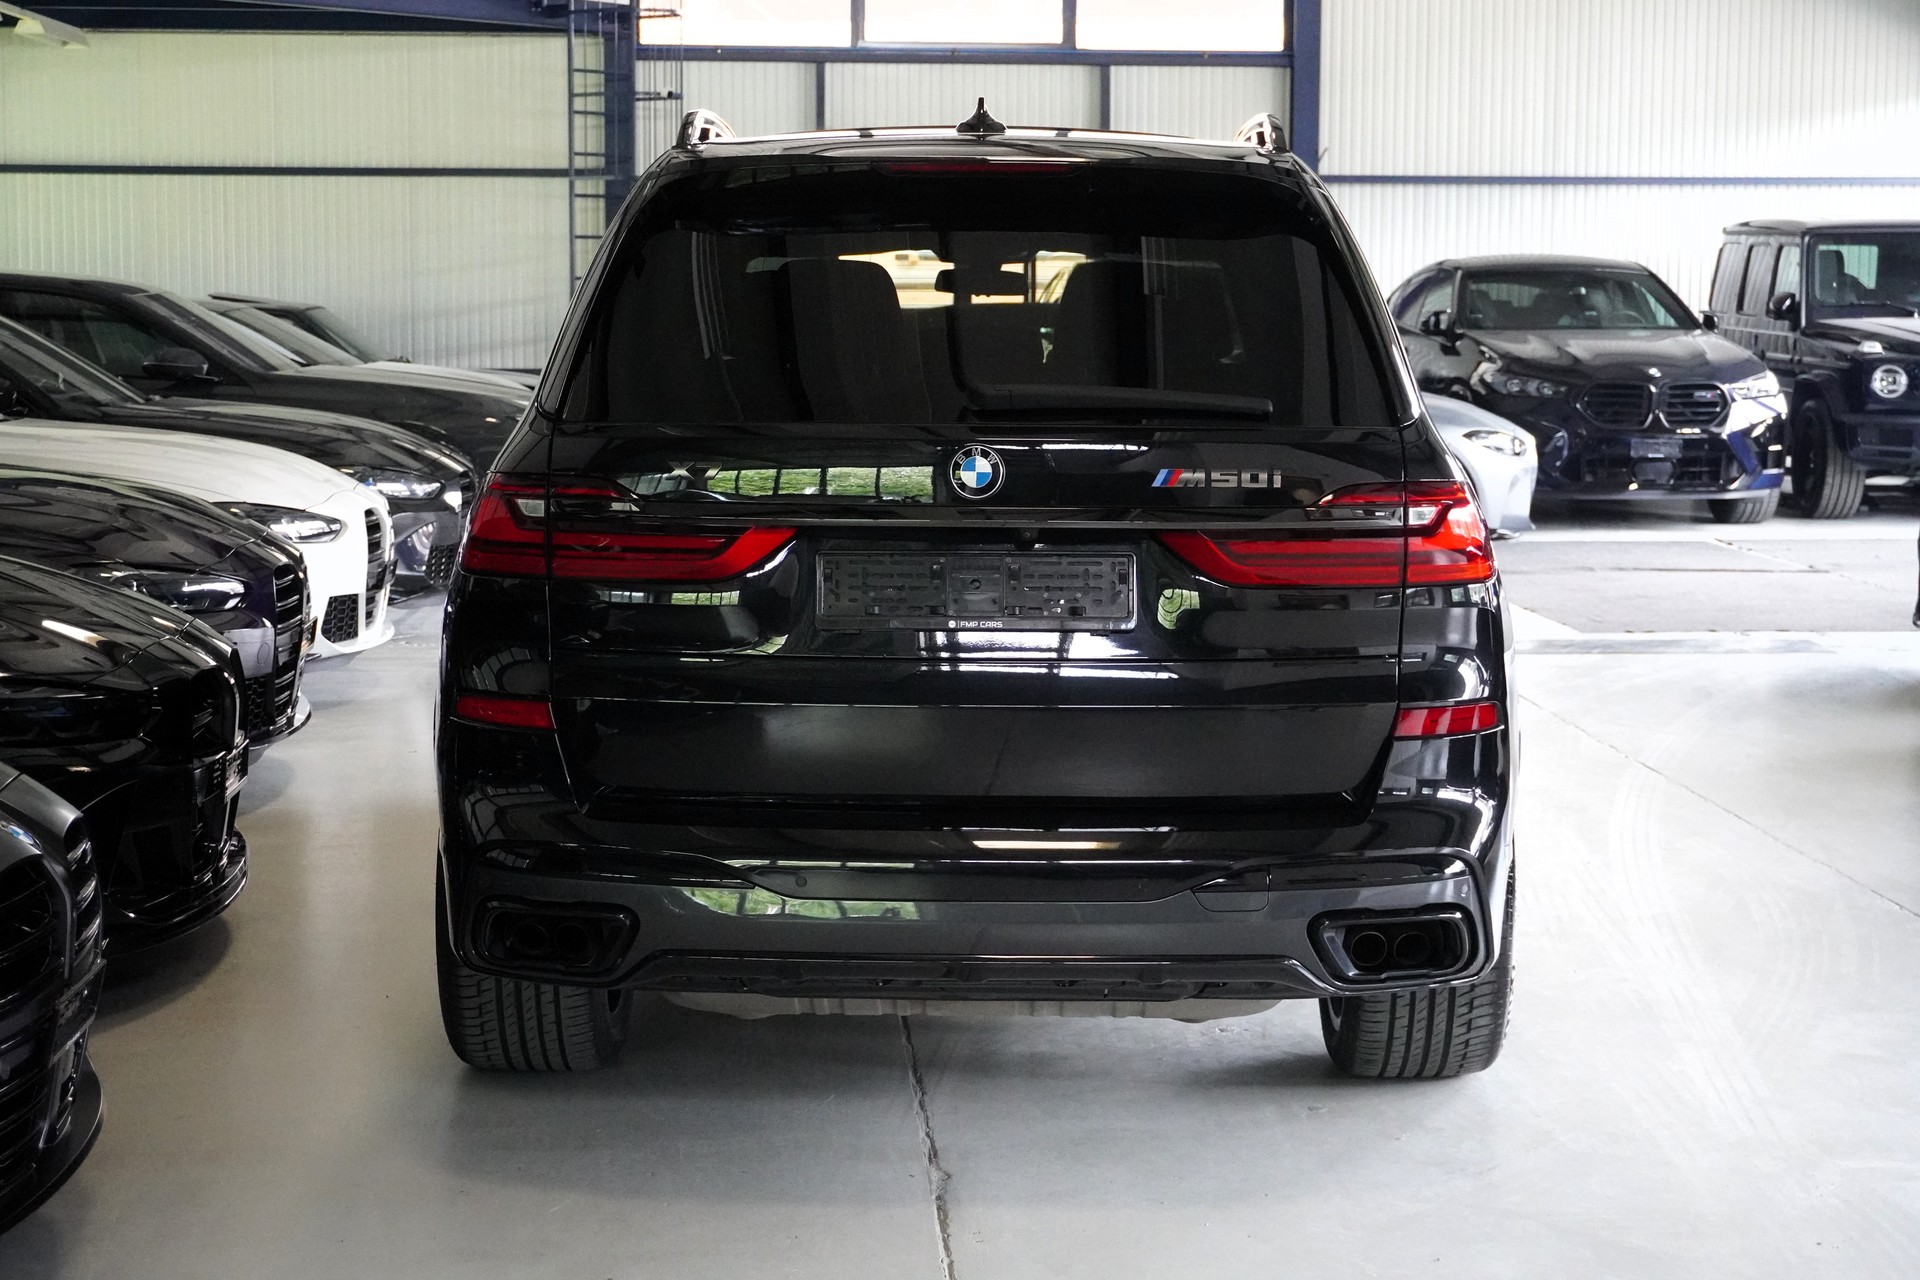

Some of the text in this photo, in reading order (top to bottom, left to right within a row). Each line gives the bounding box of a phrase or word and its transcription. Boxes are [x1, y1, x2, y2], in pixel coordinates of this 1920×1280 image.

[956, 447, 998, 464] BMW
[668, 461, 723, 480] X7
[1174, 468, 1282, 488] M50i
